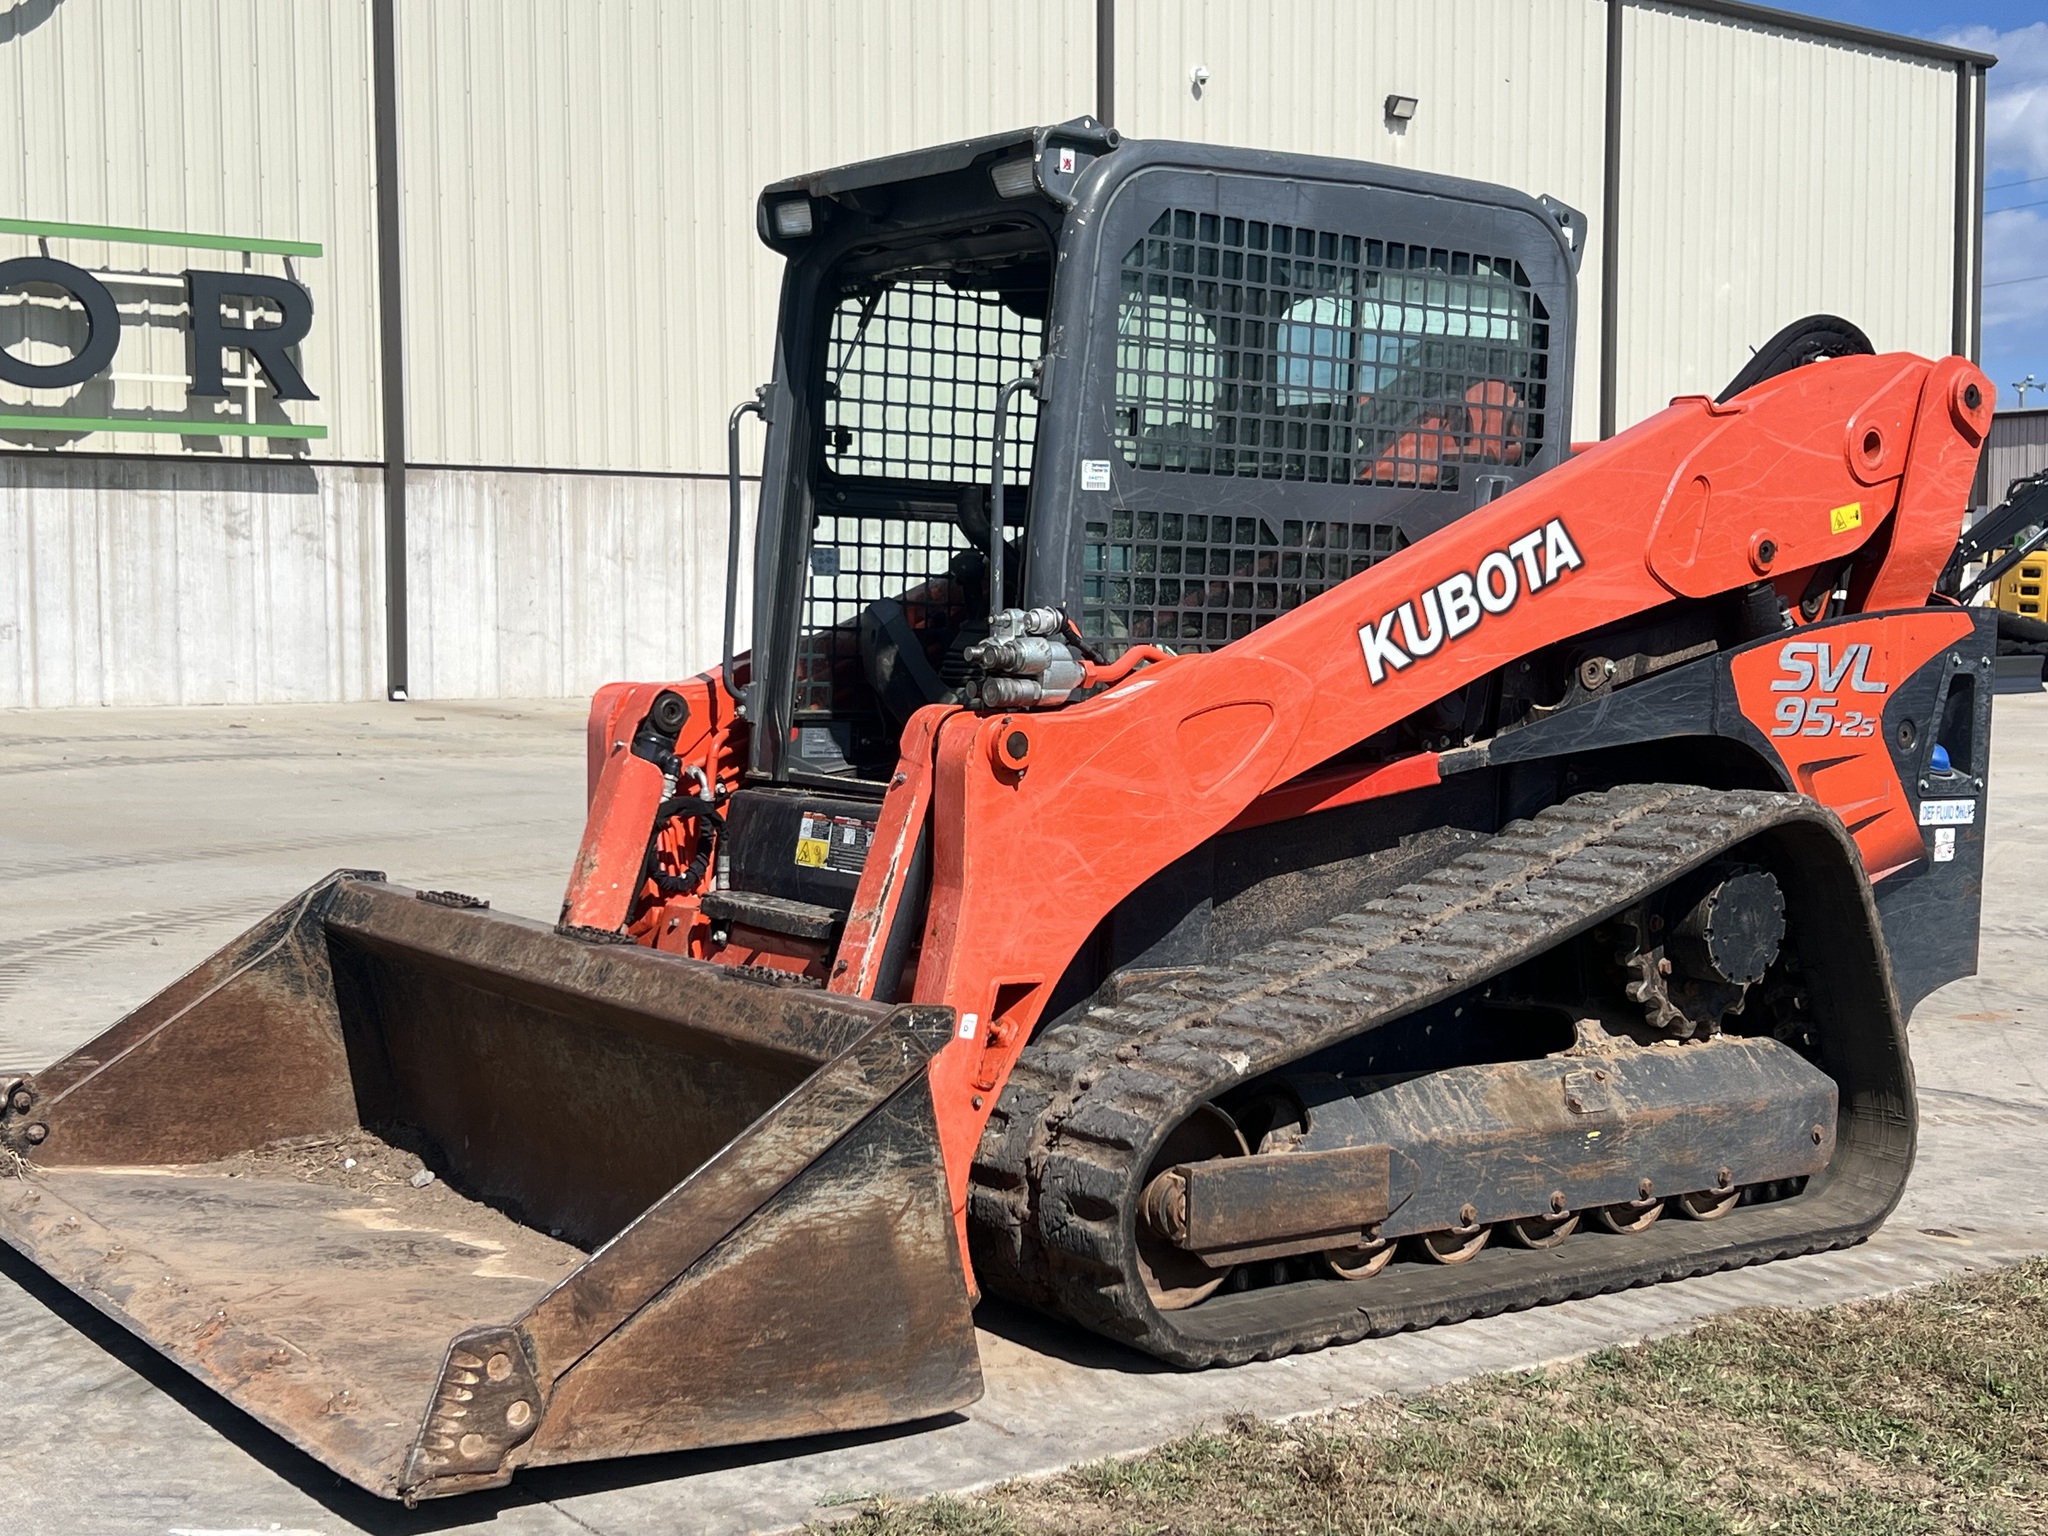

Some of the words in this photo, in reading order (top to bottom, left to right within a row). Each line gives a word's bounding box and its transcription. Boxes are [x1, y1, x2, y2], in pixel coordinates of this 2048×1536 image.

[1357, 517, 1583, 686] KUBOTA
[1770, 642, 1888, 693] SVL
[1922, 805, 1935, 820] DEF
[1936, 805, 1954, 820] FLUID
